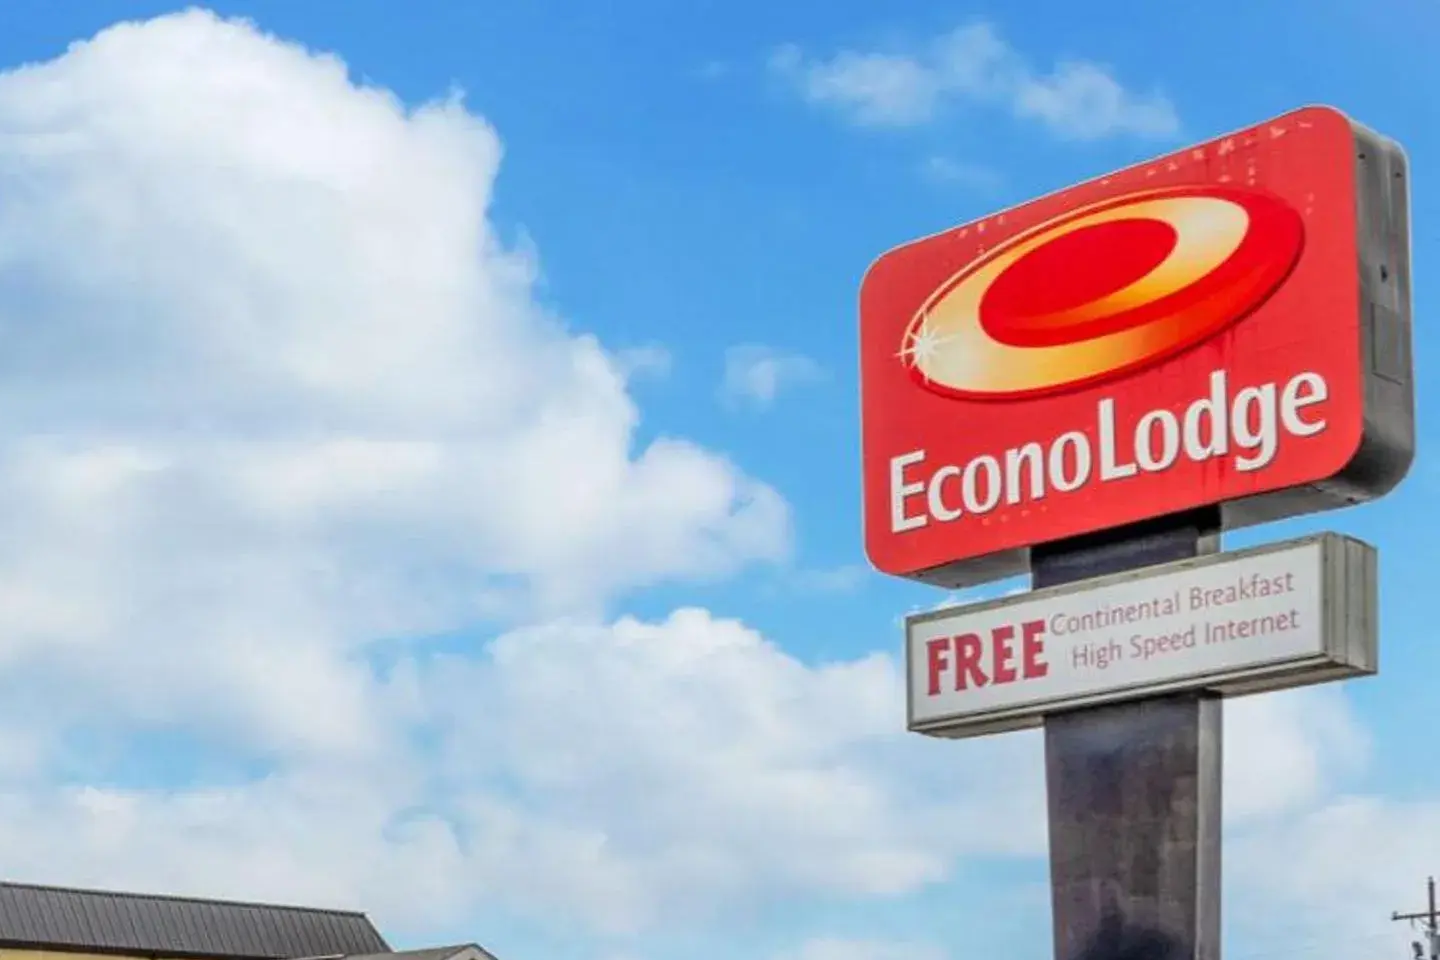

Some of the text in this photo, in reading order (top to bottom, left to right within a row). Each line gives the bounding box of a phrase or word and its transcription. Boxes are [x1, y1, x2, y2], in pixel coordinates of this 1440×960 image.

[889, 369, 1328, 534] EconoLodge
[1050, 572, 1295, 636] Continental Breakfast
[1071, 608, 1300, 670] High Speed Internet
[926, 619, 1049, 696] FREE
